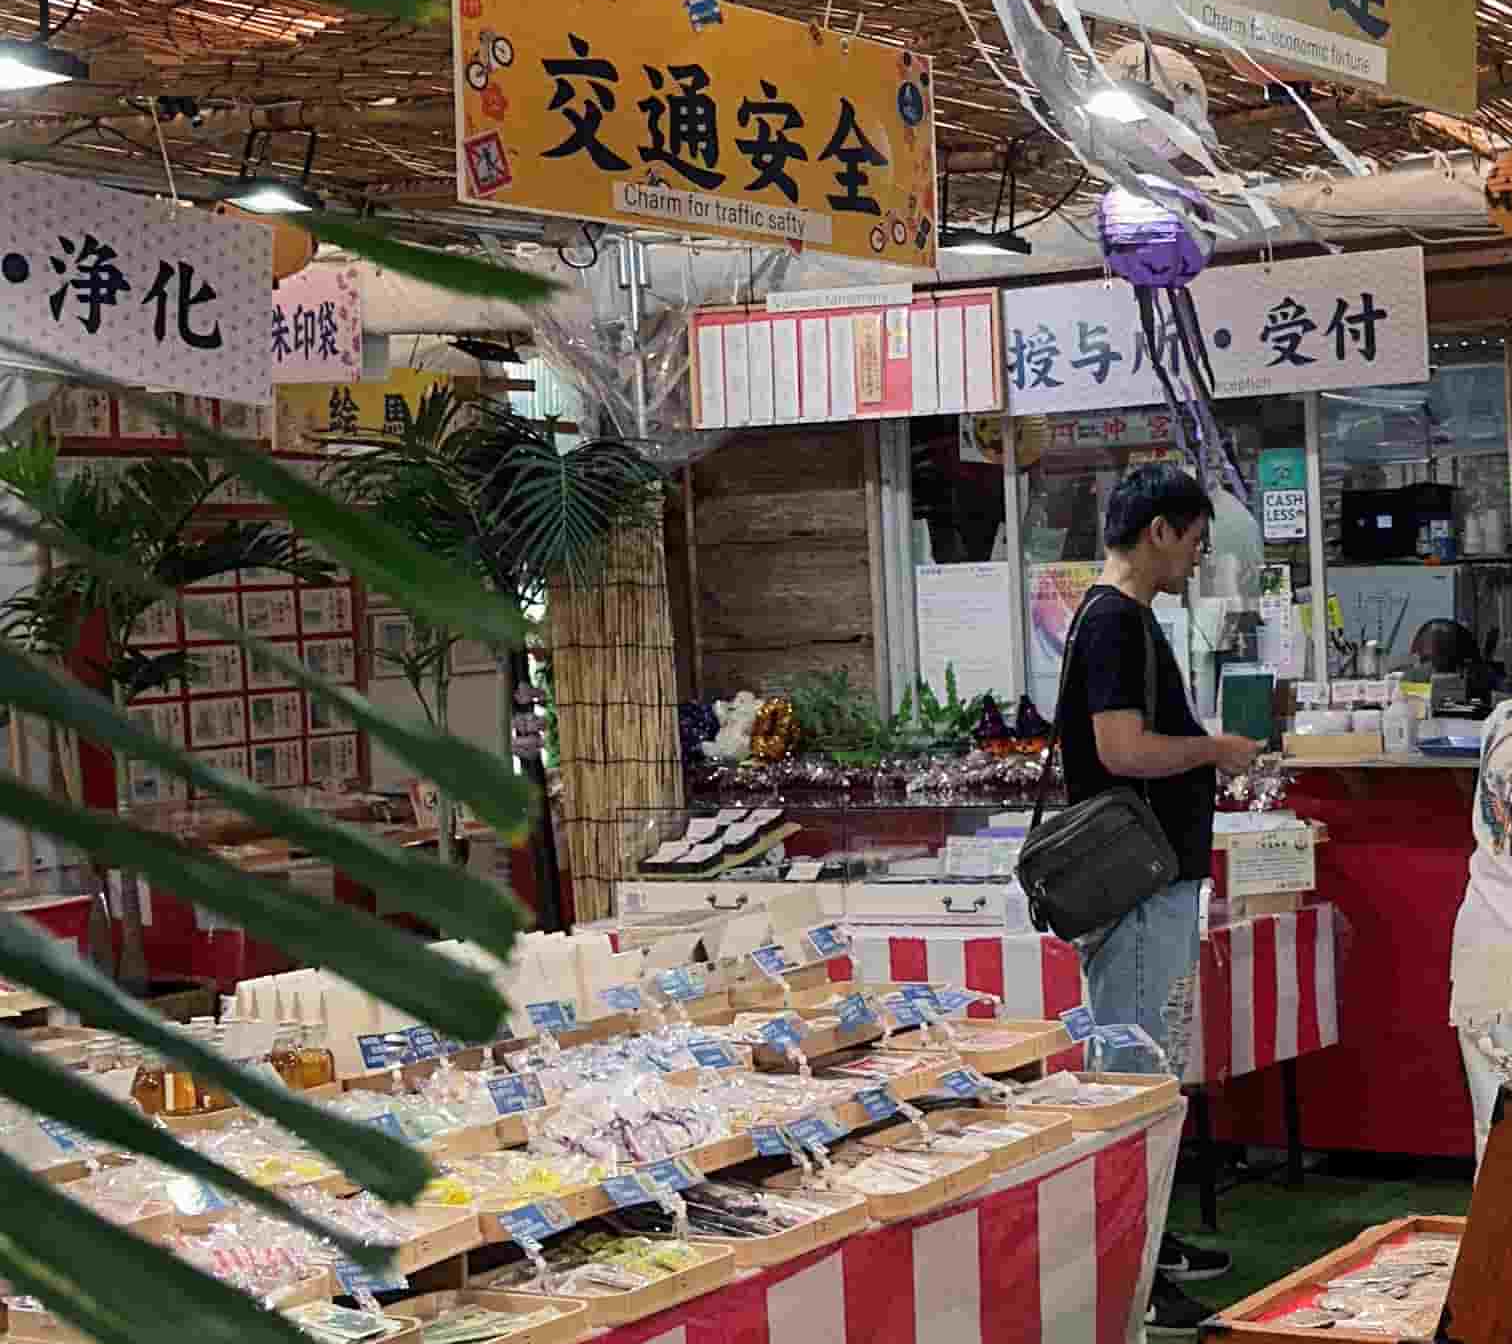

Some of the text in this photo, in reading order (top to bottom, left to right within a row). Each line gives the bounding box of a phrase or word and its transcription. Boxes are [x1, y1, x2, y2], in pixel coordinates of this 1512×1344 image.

[539, 32, 891, 218] 交通安全
[624, 183, 807, 237] Charm for traffic safty
[1266, 494, 1304, 506] CASH
[1266, 509, 1296, 521] LESS
